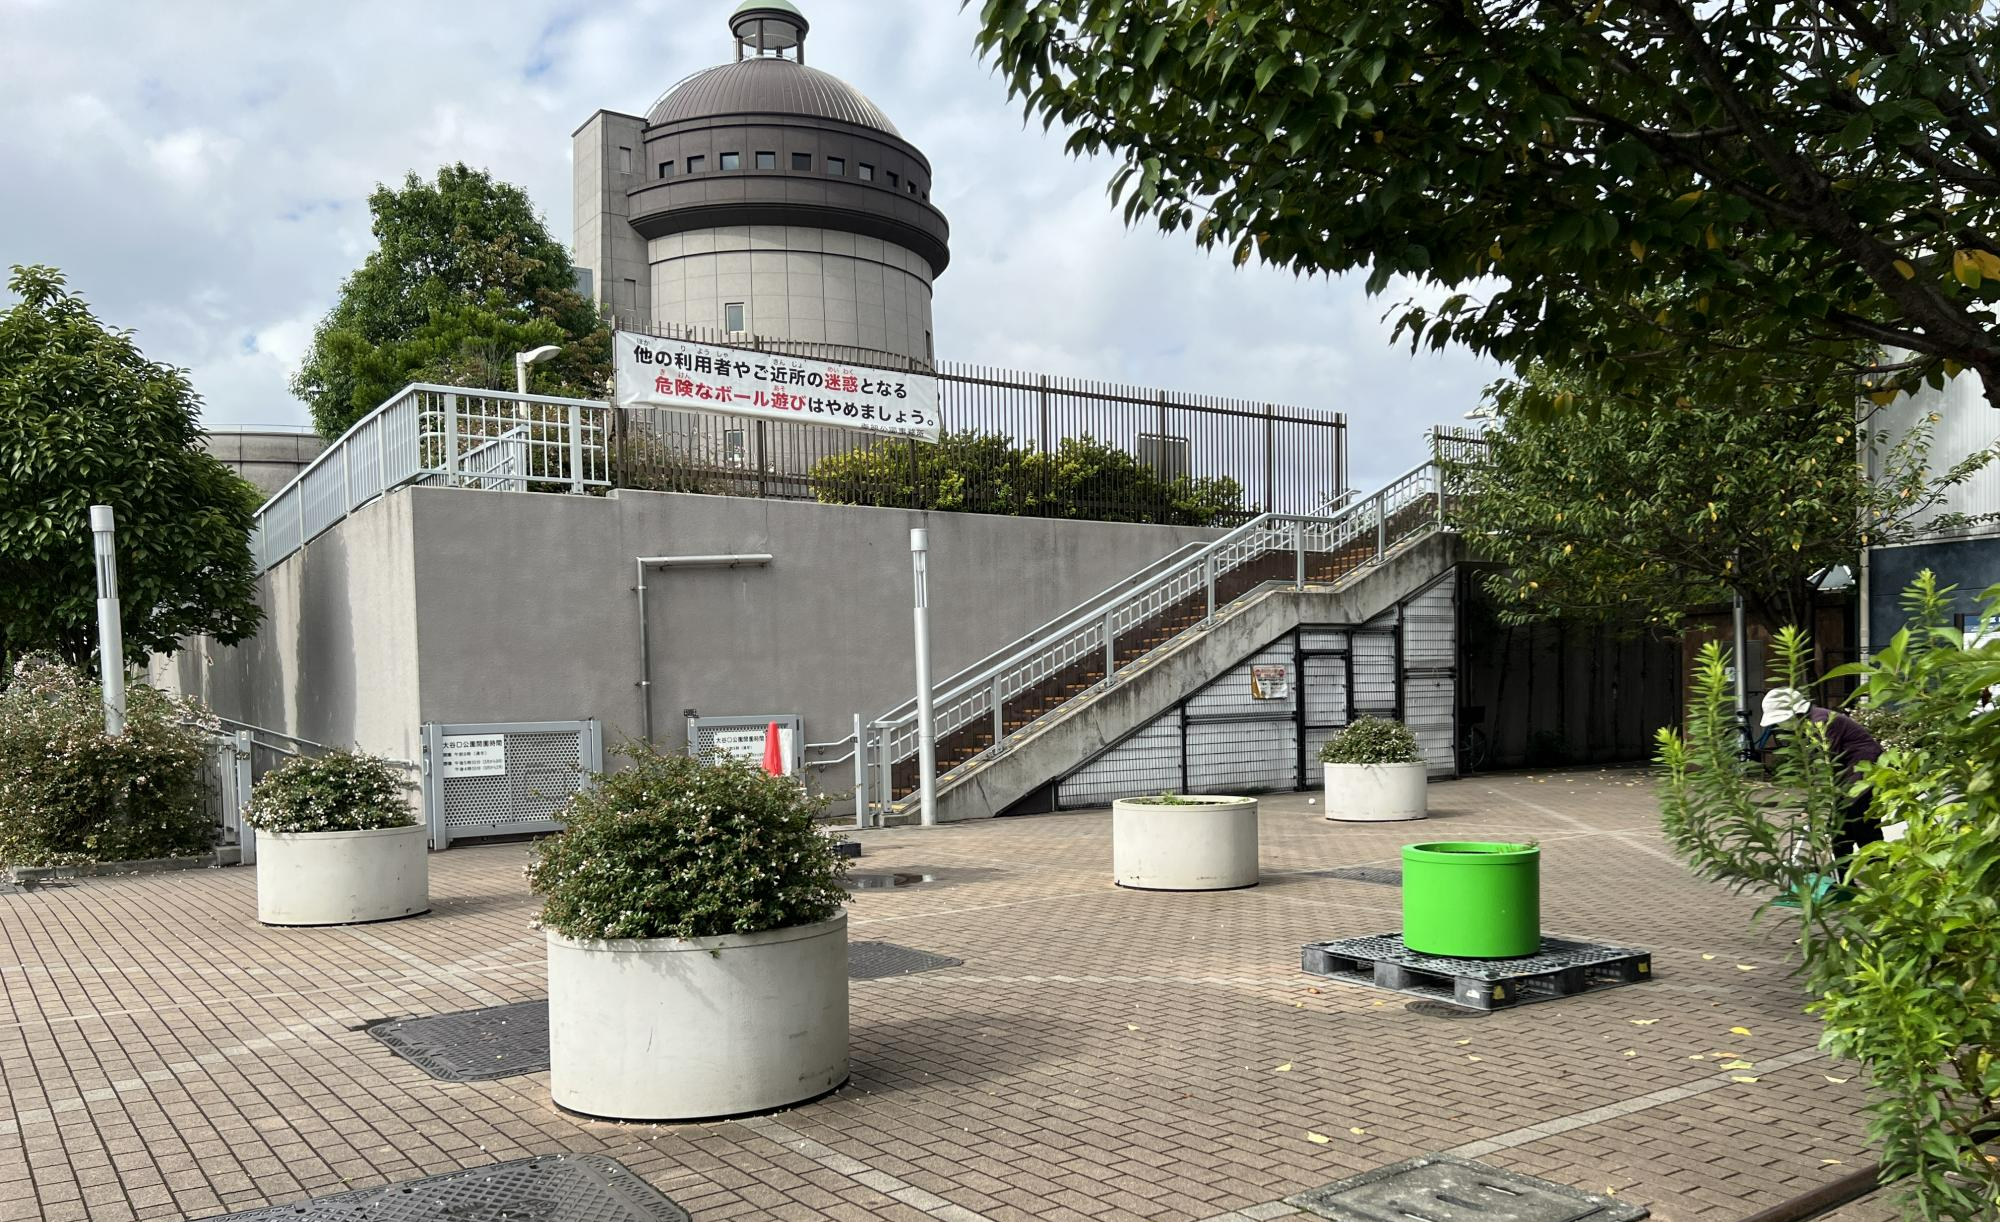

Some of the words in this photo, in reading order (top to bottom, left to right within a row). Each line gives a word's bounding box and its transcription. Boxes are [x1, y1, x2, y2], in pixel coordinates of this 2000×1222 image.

[634, 345, 907, 399] 他の利用者やご近所の迷惑となる
[696, 348, 710, 356] よう
[655, 375, 934, 426] 危険なボール遊びはやめましょう。
